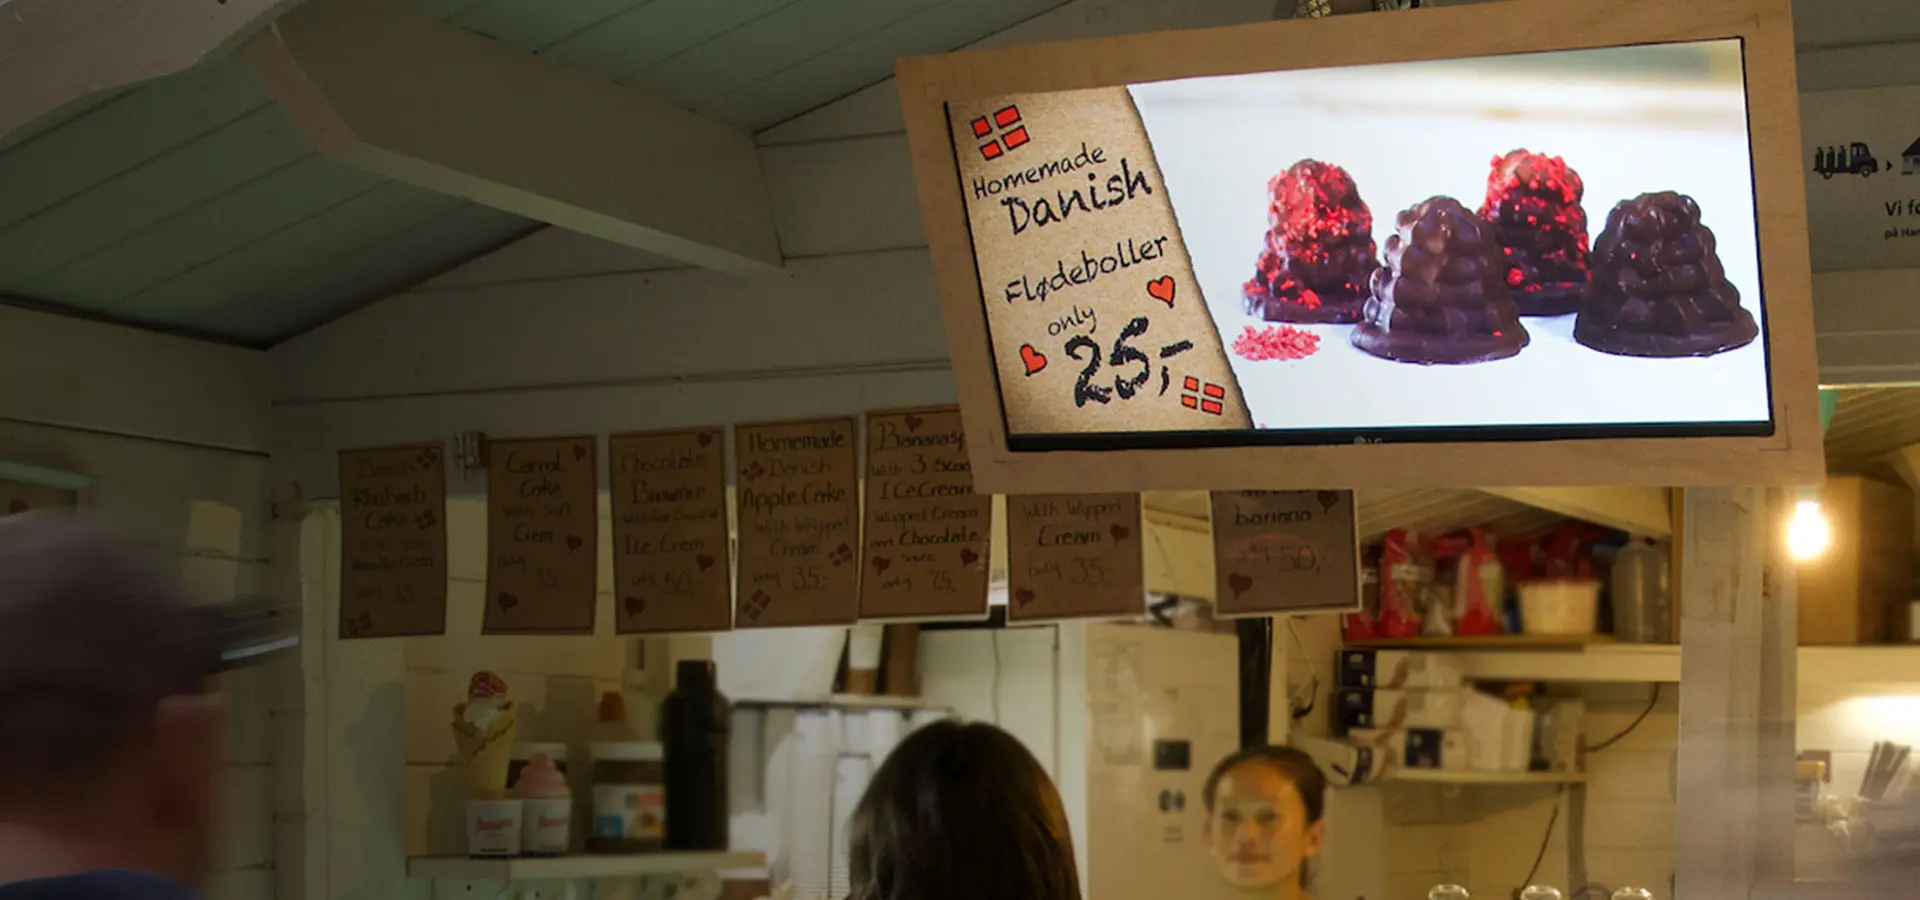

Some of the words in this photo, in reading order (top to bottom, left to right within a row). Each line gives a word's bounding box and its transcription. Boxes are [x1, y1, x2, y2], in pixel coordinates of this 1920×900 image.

[973, 142, 1107, 200] Homemade
[1001, 158, 1153, 235] Danish
[1884, 200, 1902, 217] Vi
[1004, 235, 1169, 304] Flødeboller
[1048, 304, 1098, 337] only
[1064, 316, 1194, 409] 25,-
[749, 429, 845, 453] Homemade
[769, 455, 831, 478] Danish
[909, 453, 927, 475] 3
[742, 482, 799, 516] Apple
[1233, 503, 1313, 527] banana
[1037, 524, 1102, 548] Cream
